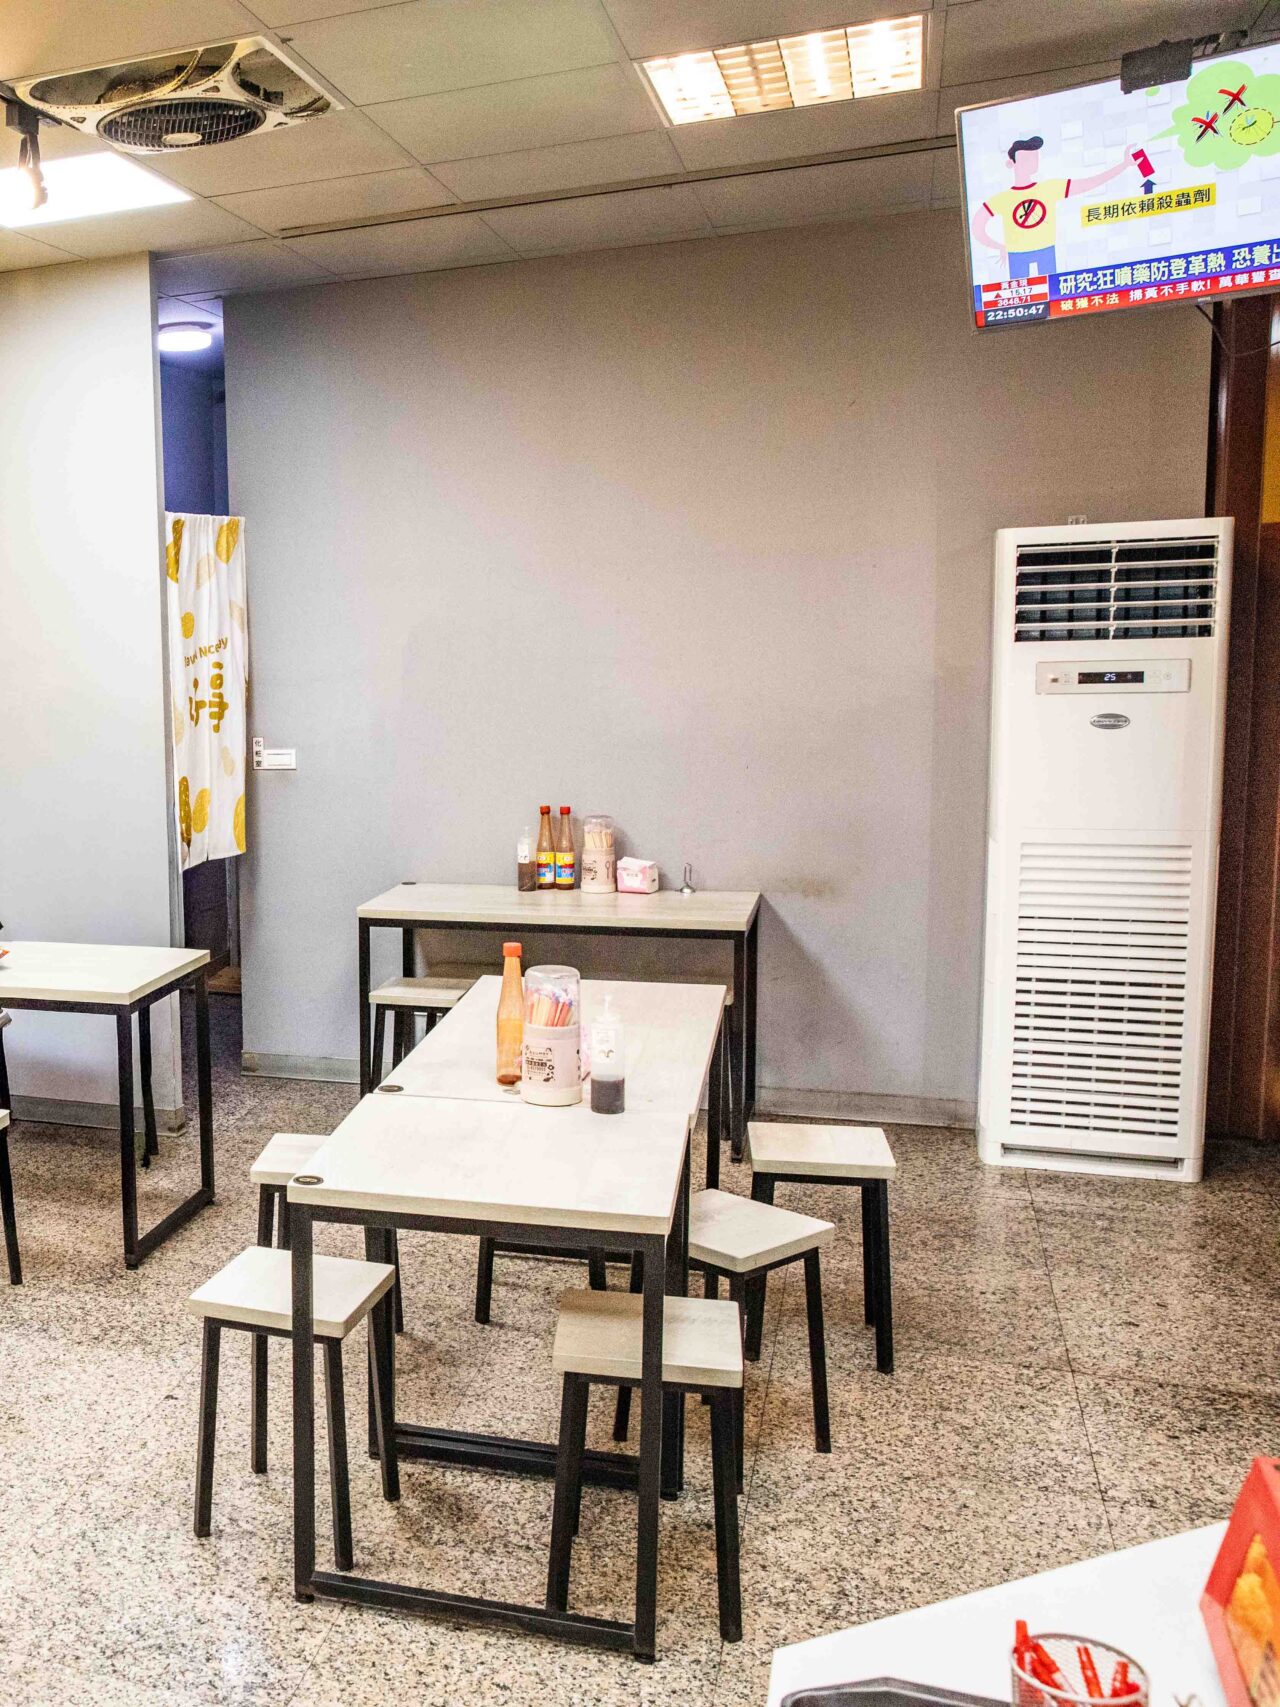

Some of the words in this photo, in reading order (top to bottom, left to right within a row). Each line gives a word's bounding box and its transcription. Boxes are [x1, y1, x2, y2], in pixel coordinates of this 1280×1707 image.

[1086, 187, 1210, 222] 長期依賴殺蟲劑
[987, 304, 1045, 321] 22:50:47
[1104, 673, 1116, 681] 25
